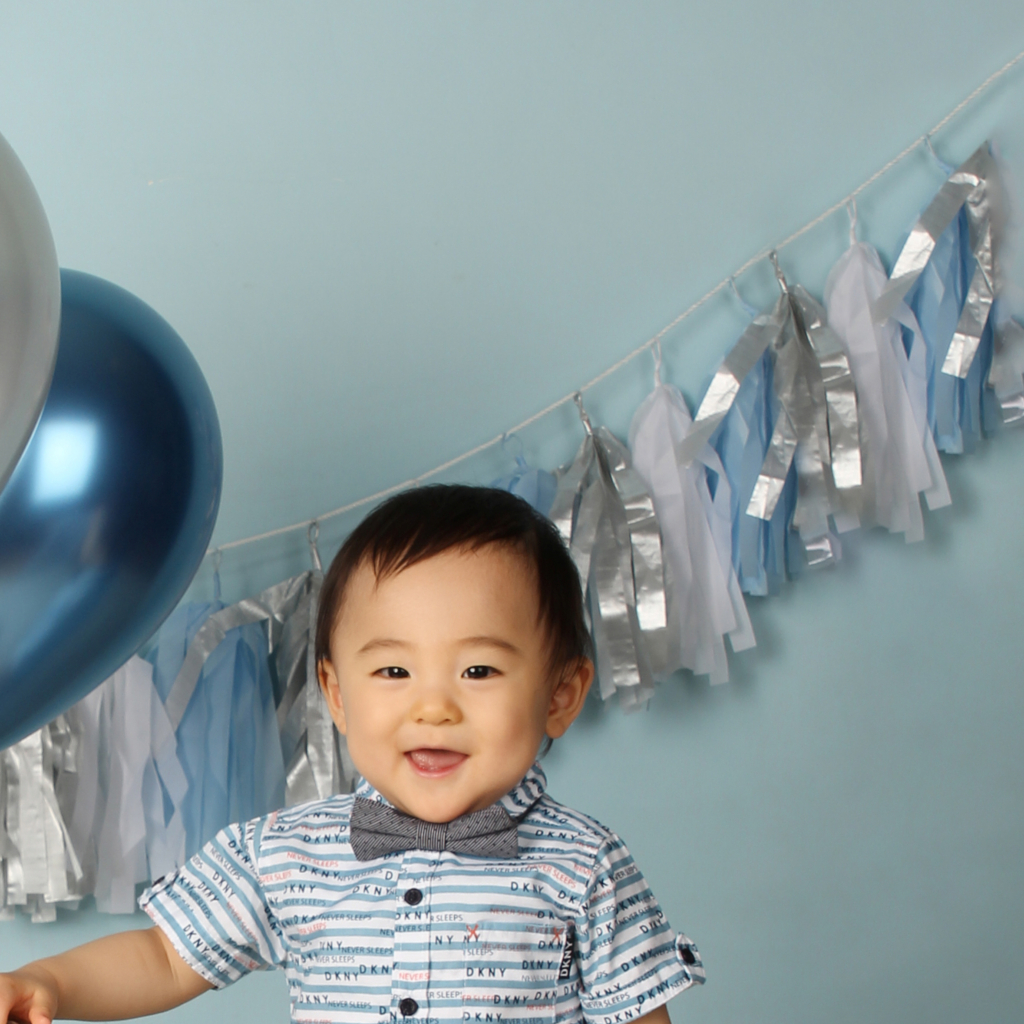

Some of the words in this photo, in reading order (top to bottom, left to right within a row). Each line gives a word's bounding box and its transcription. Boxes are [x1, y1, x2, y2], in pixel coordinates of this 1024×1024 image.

[304, 834, 340, 843] DKNY
[536, 830, 577, 840] DKNY
[287, 852, 311, 863] NEVER
[314, 859, 339, 868] SLEEPS
[300, 865, 340, 878] DKNY
[338, 873, 359, 881] NEVER
[552, 869, 576, 889] SLEEPS
[213, 872, 236, 898] DKNY
[353, 885, 390, 895] DKNY
[511, 882, 544, 894] DKNY
[198, 882, 219, 902] DKNY
[183, 924, 210, 954] DKNY
[435, 935, 454, 945] NY
[468, 948, 494, 956] SLEEPS
[560, 940, 573, 977] DKNY
[621, 950, 654, 972] DKNY
[522, 960, 553, 969] DKNY
[325, 972, 358, 981] DKNY
[467, 967, 506, 978] DKNY
[637, 980, 670, 1004] DKNY
[327, 1000, 348, 1008] NEVER
[350, 1001, 372, 1009] SLEEPS
[494, 995, 530, 1005] DKNY
[604, 993, 630, 1005] SLEEPS
[463, 1012, 501, 1022] DKNY
